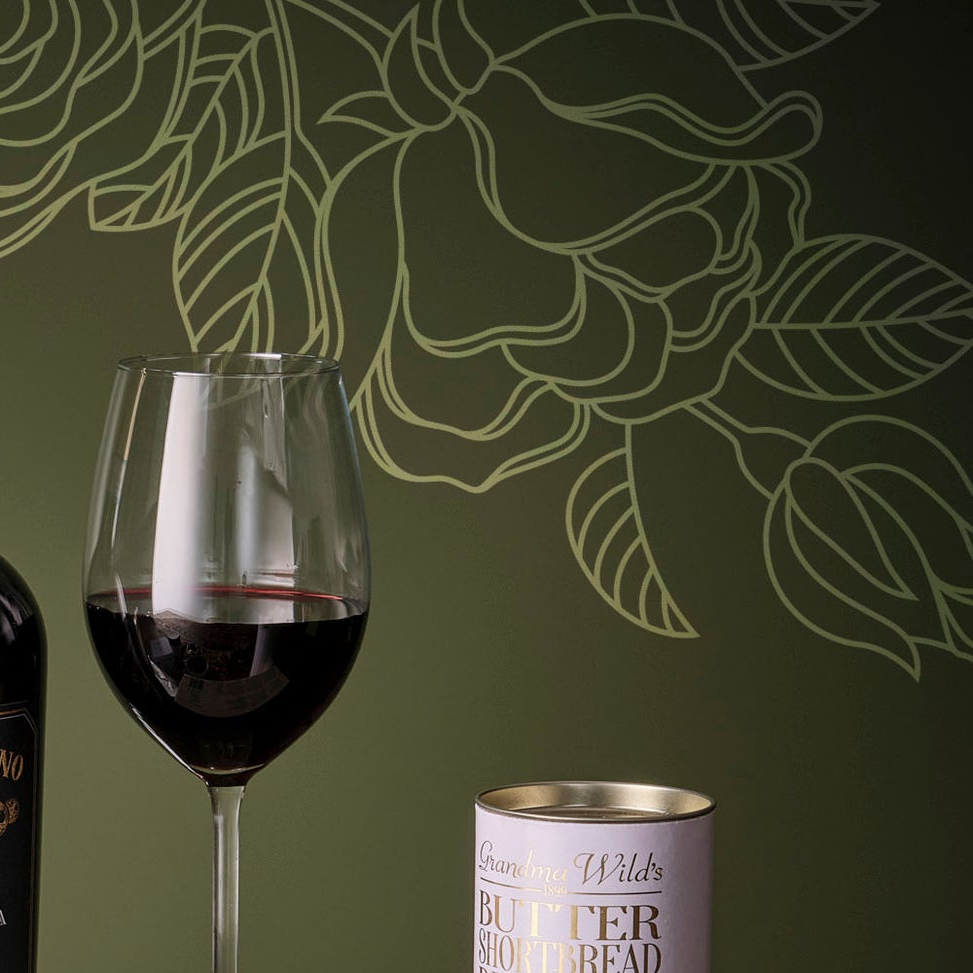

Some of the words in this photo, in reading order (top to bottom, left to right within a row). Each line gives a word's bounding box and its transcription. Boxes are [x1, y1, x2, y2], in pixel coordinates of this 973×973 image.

[478, 840, 568, 883] Grandma
[573, 852, 663, 886] Wild's
[479, 889, 662, 941] BUTTER
